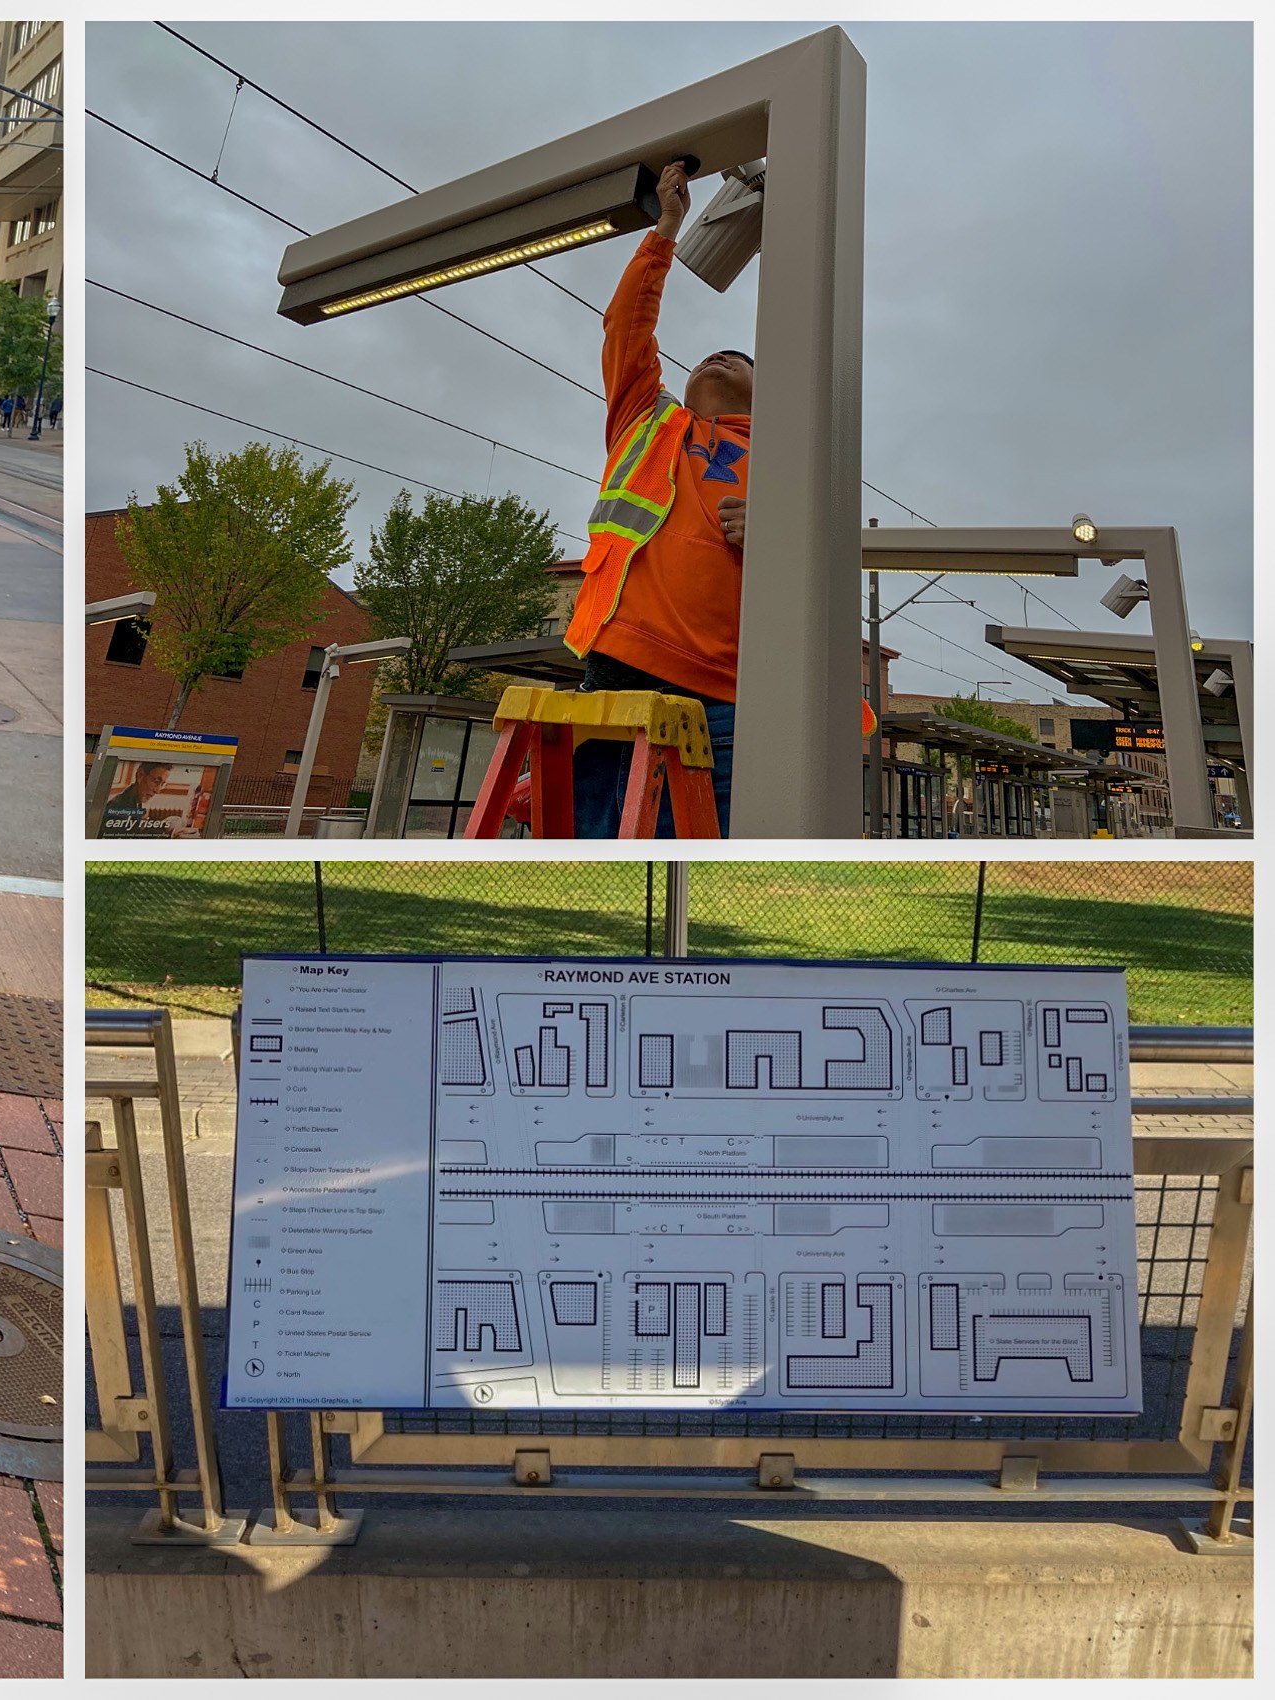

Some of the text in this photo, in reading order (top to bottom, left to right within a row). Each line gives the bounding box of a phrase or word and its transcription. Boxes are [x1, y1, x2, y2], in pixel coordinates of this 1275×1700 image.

[107, 808, 131, 816] Recycling
[106, 816, 171, 831] early risers
[300, 966, 349, 976] Map Key
[544, 970, 731, 985] RAYMOND AVE STATION
[492, 1031, 500, 1059] Raymond
[661, 1137, 735, 1147] C T C
[660, 1224, 735, 1233] C T C
[300, 1268, 314, 1276] Stop
[253, 1300, 261, 1308] C
[253, 1341, 259, 1349] T
